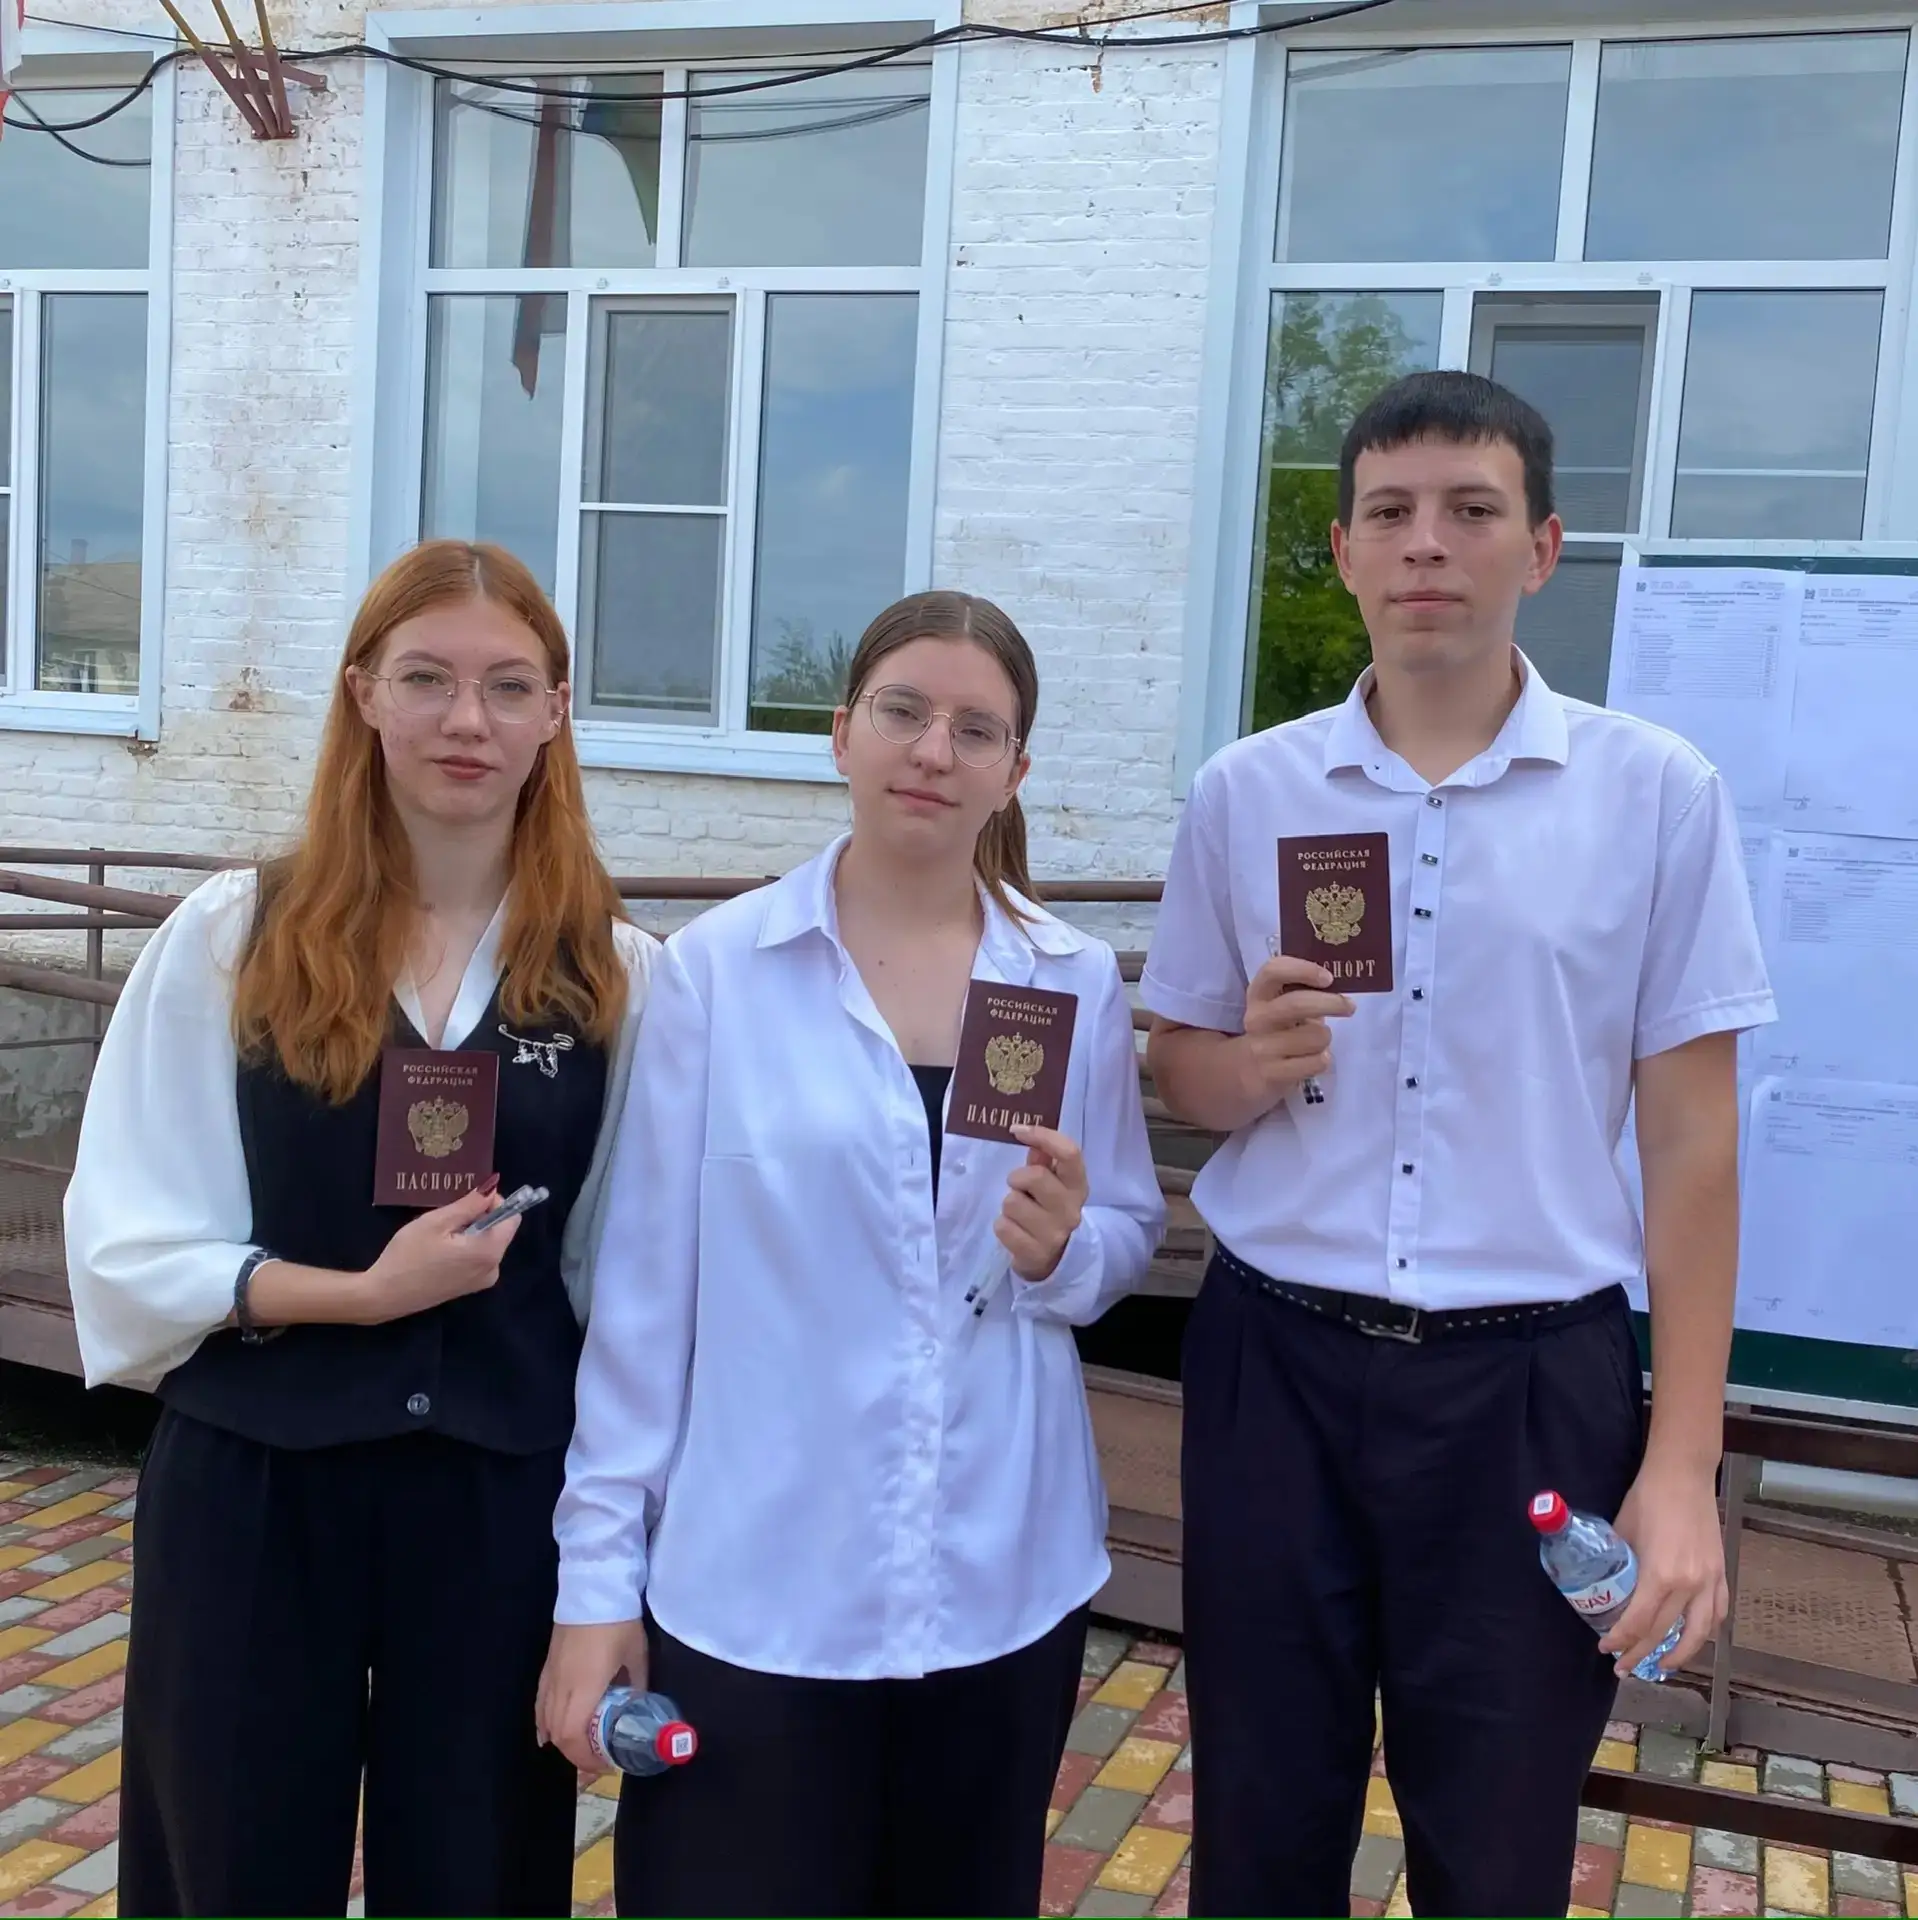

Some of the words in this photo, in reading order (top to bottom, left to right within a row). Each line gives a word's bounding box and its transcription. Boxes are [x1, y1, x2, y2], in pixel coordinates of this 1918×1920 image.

[1298, 849, 1370, 860] РОССИЙСКАЯ
[1302, 861, 1367, 872] ФЕДЕРАЦИЯ
[987, 997, 1058, 1015] РОССИЙСКАЯ
[990, 1008, 1052, 1026] ФЕДЕРАЦИЯ
[403, 1064, 478, 1075] РОССИЙСКАЯ
[407, 1076, 474, 1087] ФЕДЕРАЦИЯ
[397, 1172, 475, 1190] ПАСПОРТ
